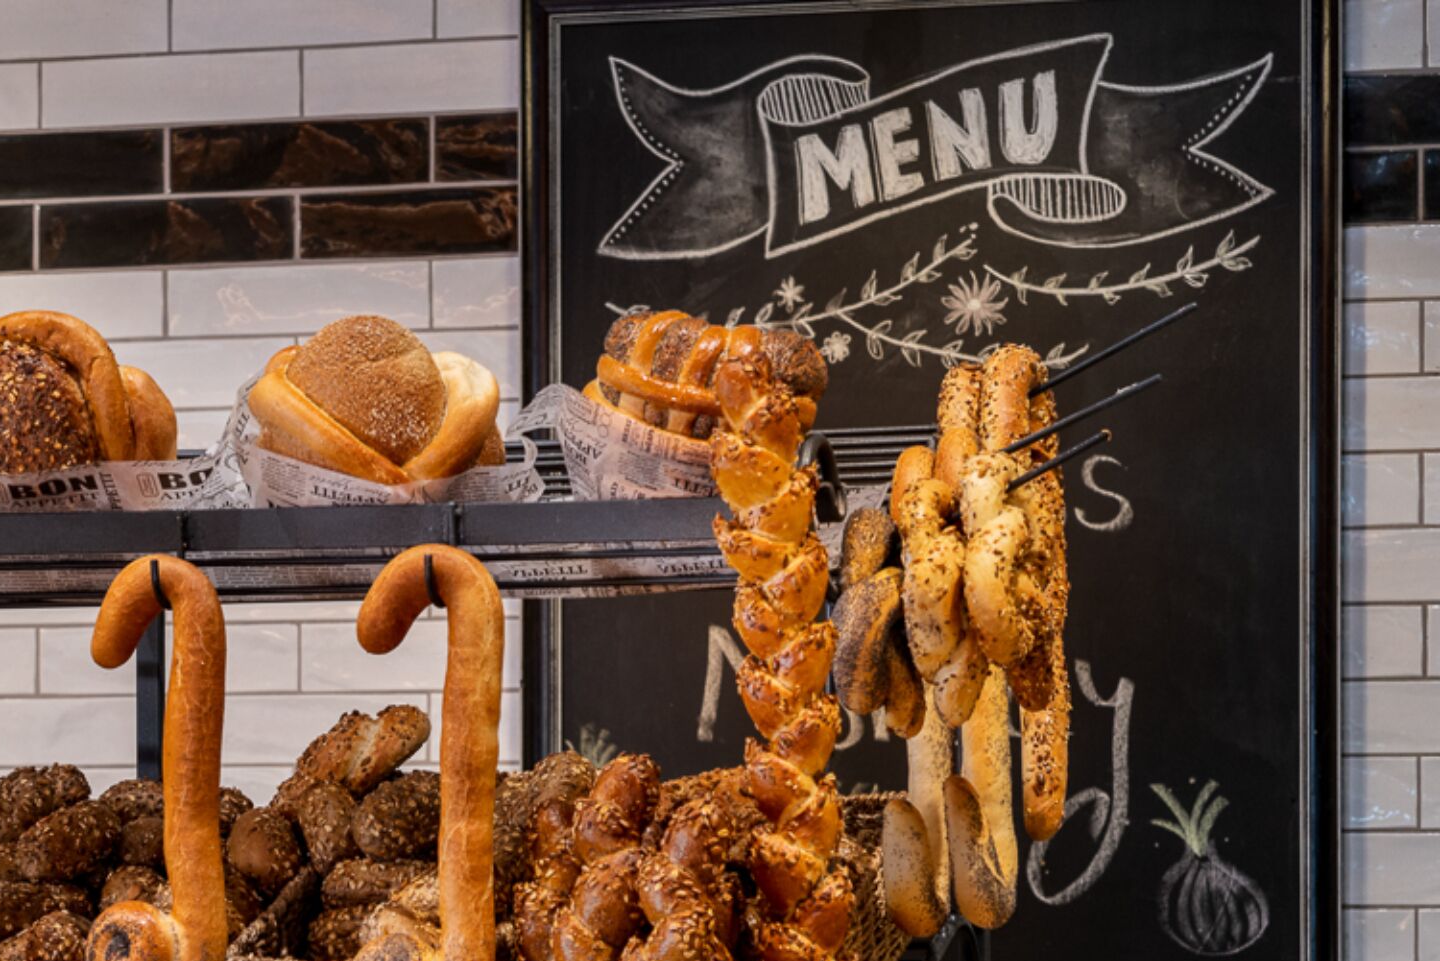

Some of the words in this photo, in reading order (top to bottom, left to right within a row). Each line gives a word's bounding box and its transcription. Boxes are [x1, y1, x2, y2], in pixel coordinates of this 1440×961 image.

[794, 69, 1058, 226] MENU
[10, 474, 98, 501] BON
[160, 467, 214, 490] BO
